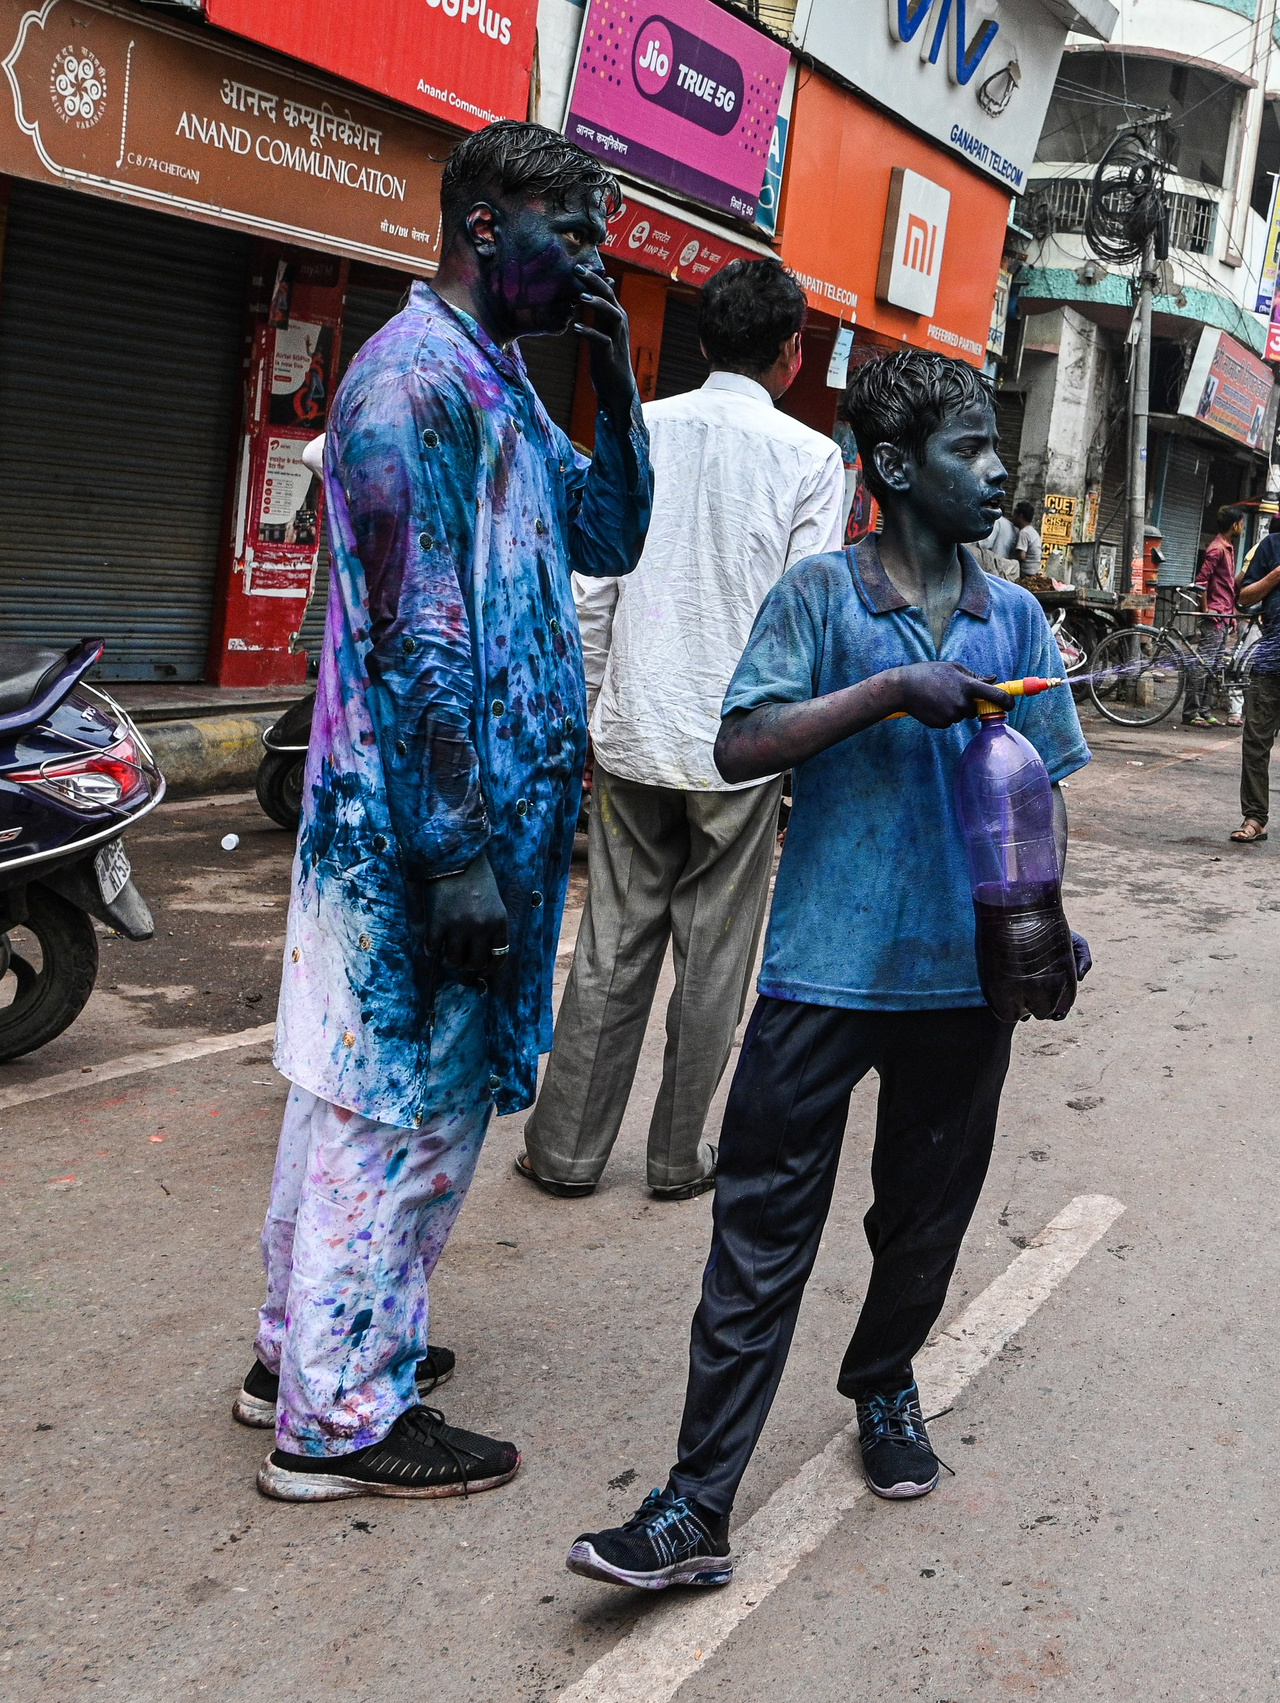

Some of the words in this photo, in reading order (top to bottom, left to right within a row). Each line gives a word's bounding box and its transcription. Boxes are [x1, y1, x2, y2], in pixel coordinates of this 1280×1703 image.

[638, 40, 669, 77] Jio
[416, 78, 448, 102] Anand
[676, 63, 715, 103] TRUE
[714, 87, 736, 113] 5G
[50, 85, 71, 123] HRIDAY
[76, 100, 107, 129] VARANASI
[219, 78, 280, 124] आनन्द
[283, 99, 383, 155] कम्यूनिकेशन
[576, 124, 595, 141] आनन्द
[127, 152, 135, 164] C
[158, 160, 200, 185] CHETGANJ
[175, 111, 252, 155] ANAND
[255, 135, 407, 201] COMMUNICATION
[950, 124, 990, 164] GANAPATI
[988, 150, 1024, 187] TELECOM
[823, 282, 858, 308] TELECOM
[926, 324, 959, 347] PREFERRED
[957, 336, 983, 357] PARTNER
[1047, 496, 1076, 511] CUET
[81, 705, 96, 721] TVS
